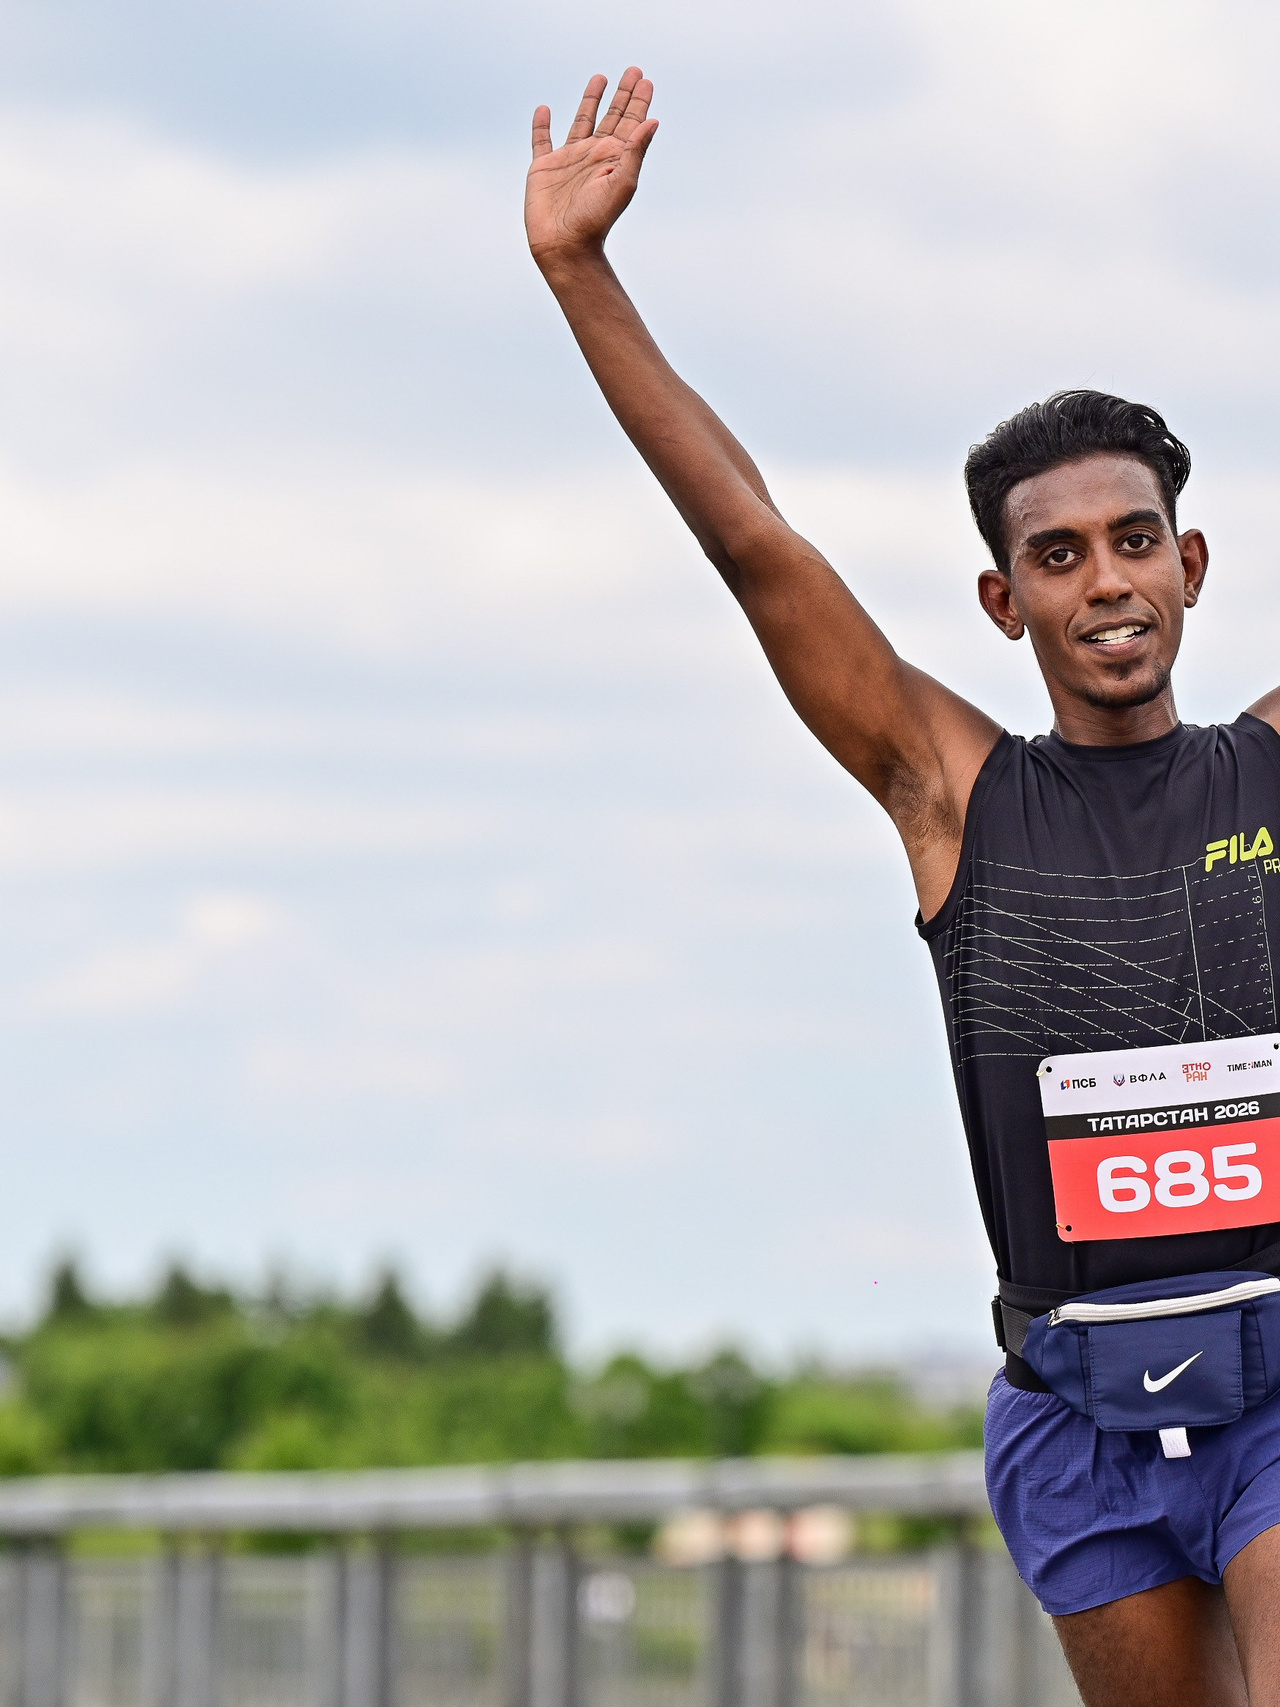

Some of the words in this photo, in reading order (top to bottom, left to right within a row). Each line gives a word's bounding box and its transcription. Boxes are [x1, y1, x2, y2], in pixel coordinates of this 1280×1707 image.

[1205, 827, 1274, 872] FILA
[1129, 1072, 1167, 1083] ВФЛА
[1182, 1061, 1211, 1074] ЭТНО
[1072, 1077, 1097, 1089] ПСБ
[1087, 1107, 1209, 1132] ТАТАРСТАН
[1214, 1101, 1260, 1119] 2026
[1096, 1142, 1263, 1213] 685
